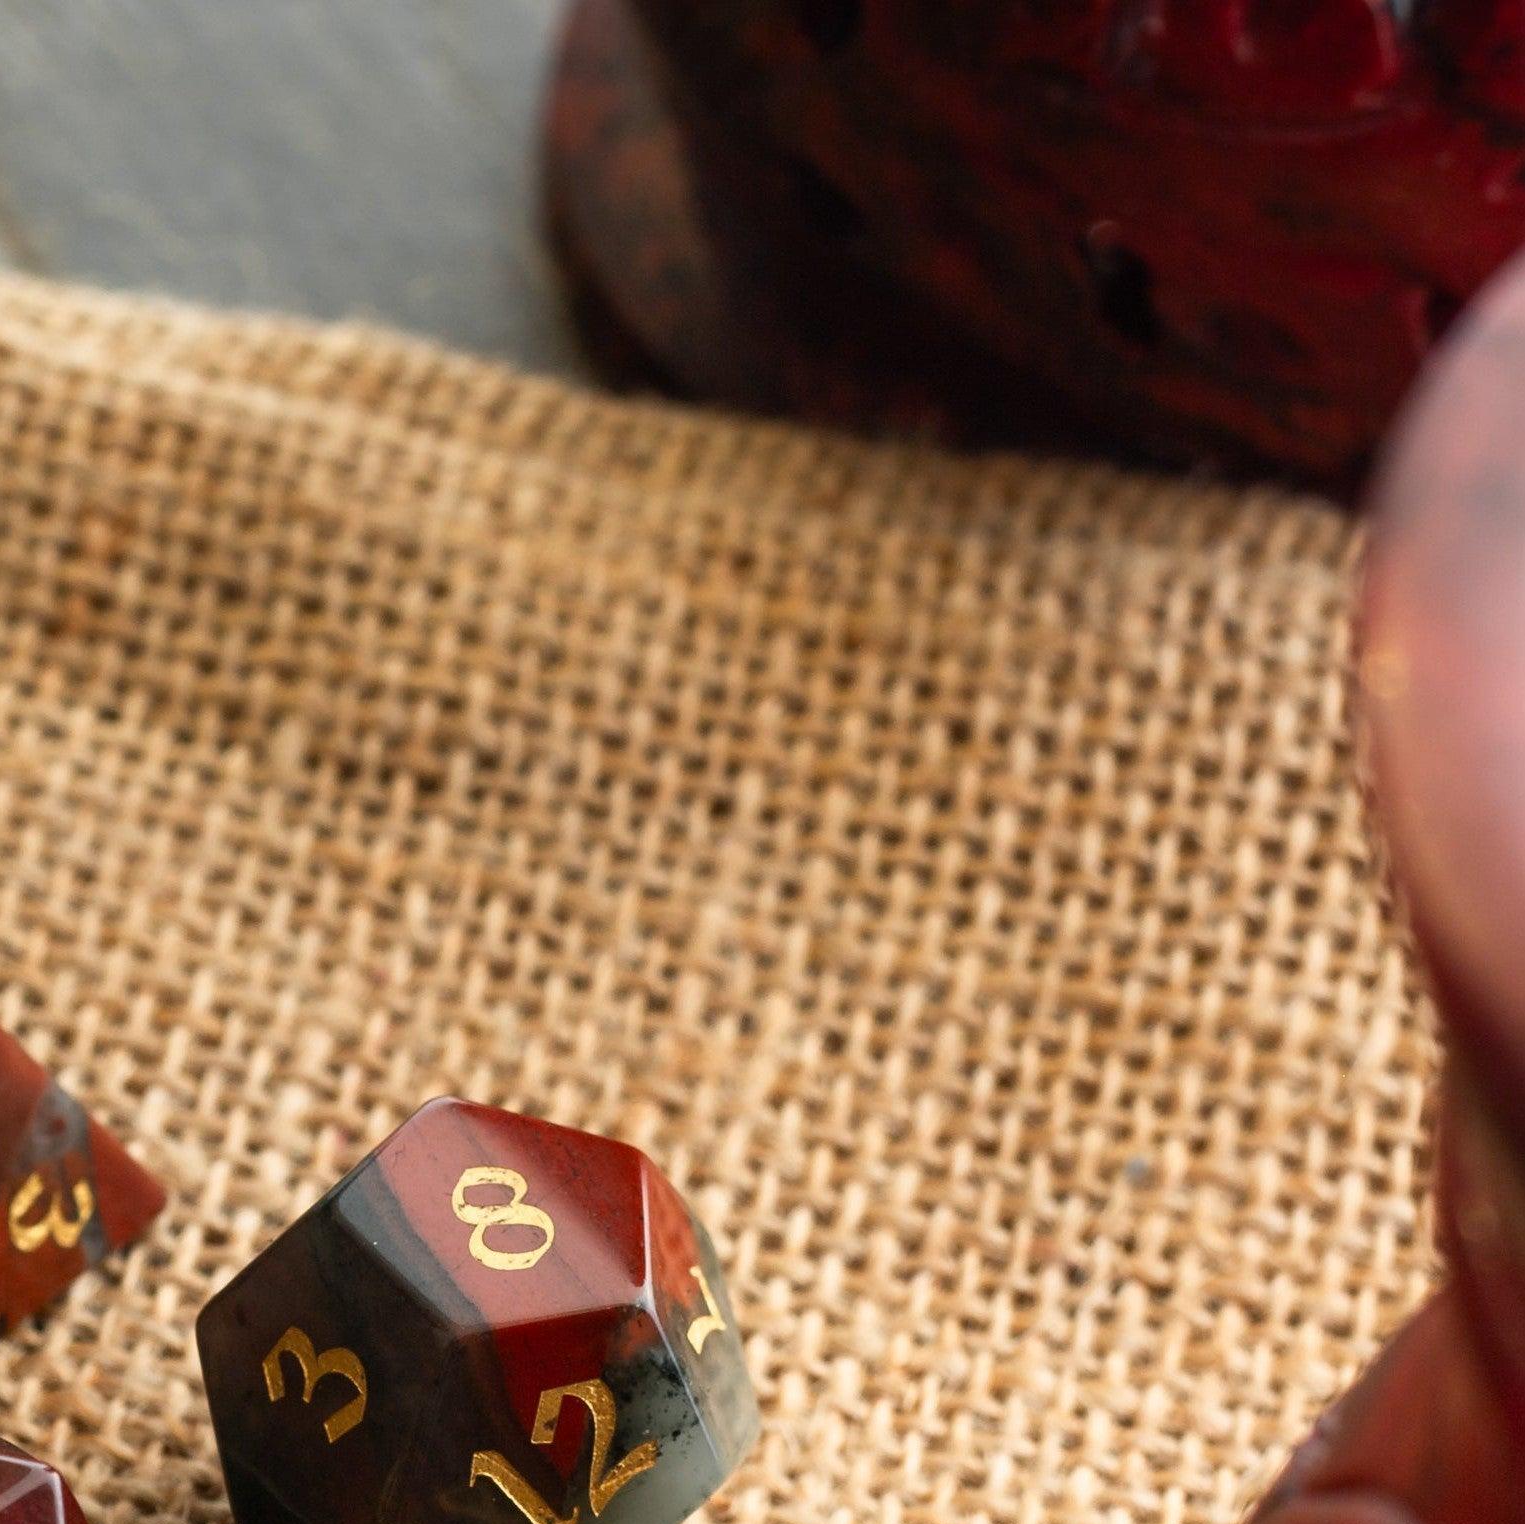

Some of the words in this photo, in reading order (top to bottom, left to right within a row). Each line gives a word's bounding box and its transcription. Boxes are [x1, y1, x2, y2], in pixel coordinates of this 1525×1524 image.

[9, 1172, 93, 1252] 3
[451, 1166, 555, 1270] 8
[262, 1325, 367, 1444] 3
